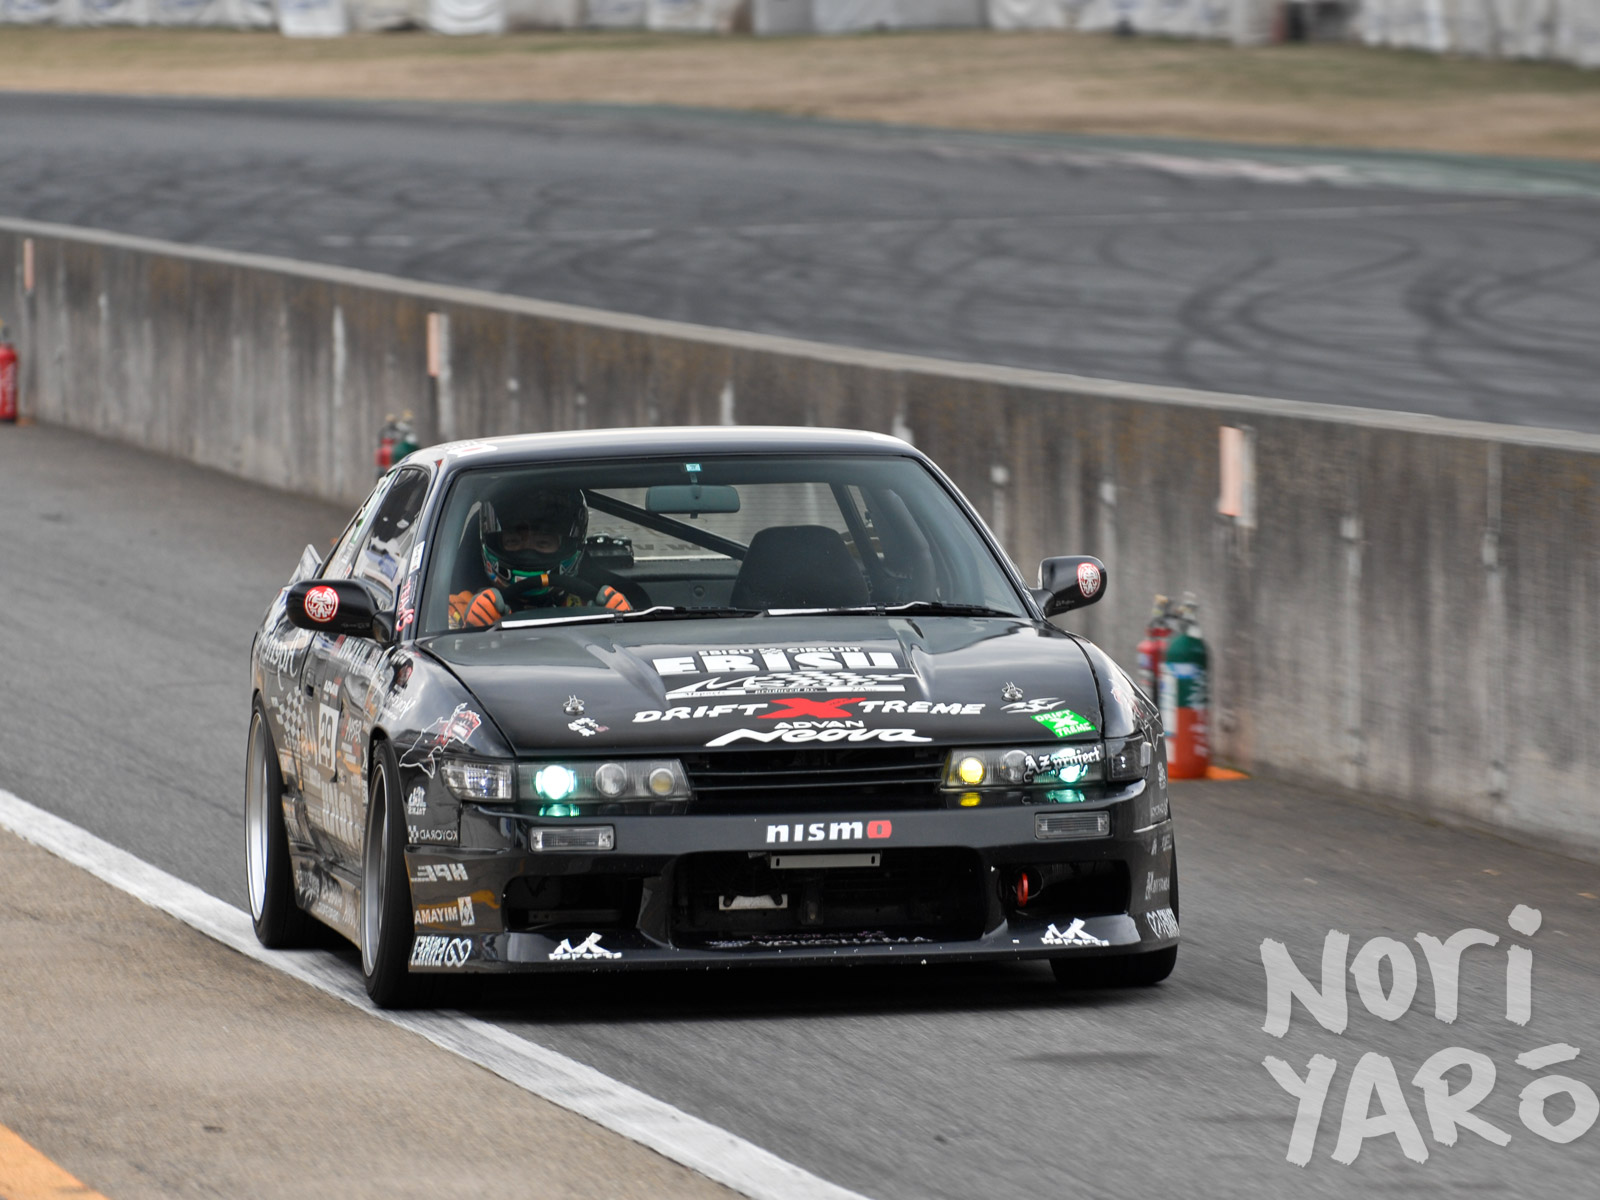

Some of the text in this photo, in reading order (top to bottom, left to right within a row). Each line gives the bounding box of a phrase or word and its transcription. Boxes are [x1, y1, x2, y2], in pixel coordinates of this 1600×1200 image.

[786, 646, 864, 654] CIRCUIT
[632, 703, 768, 723] DRIFT
[1035, 709, 1071, 722] DRIFT
[774, 720, 865, 730] ADVAN
[1055, 722, 1092, 737] TREME
[705, 729, 933, 747] Neova
